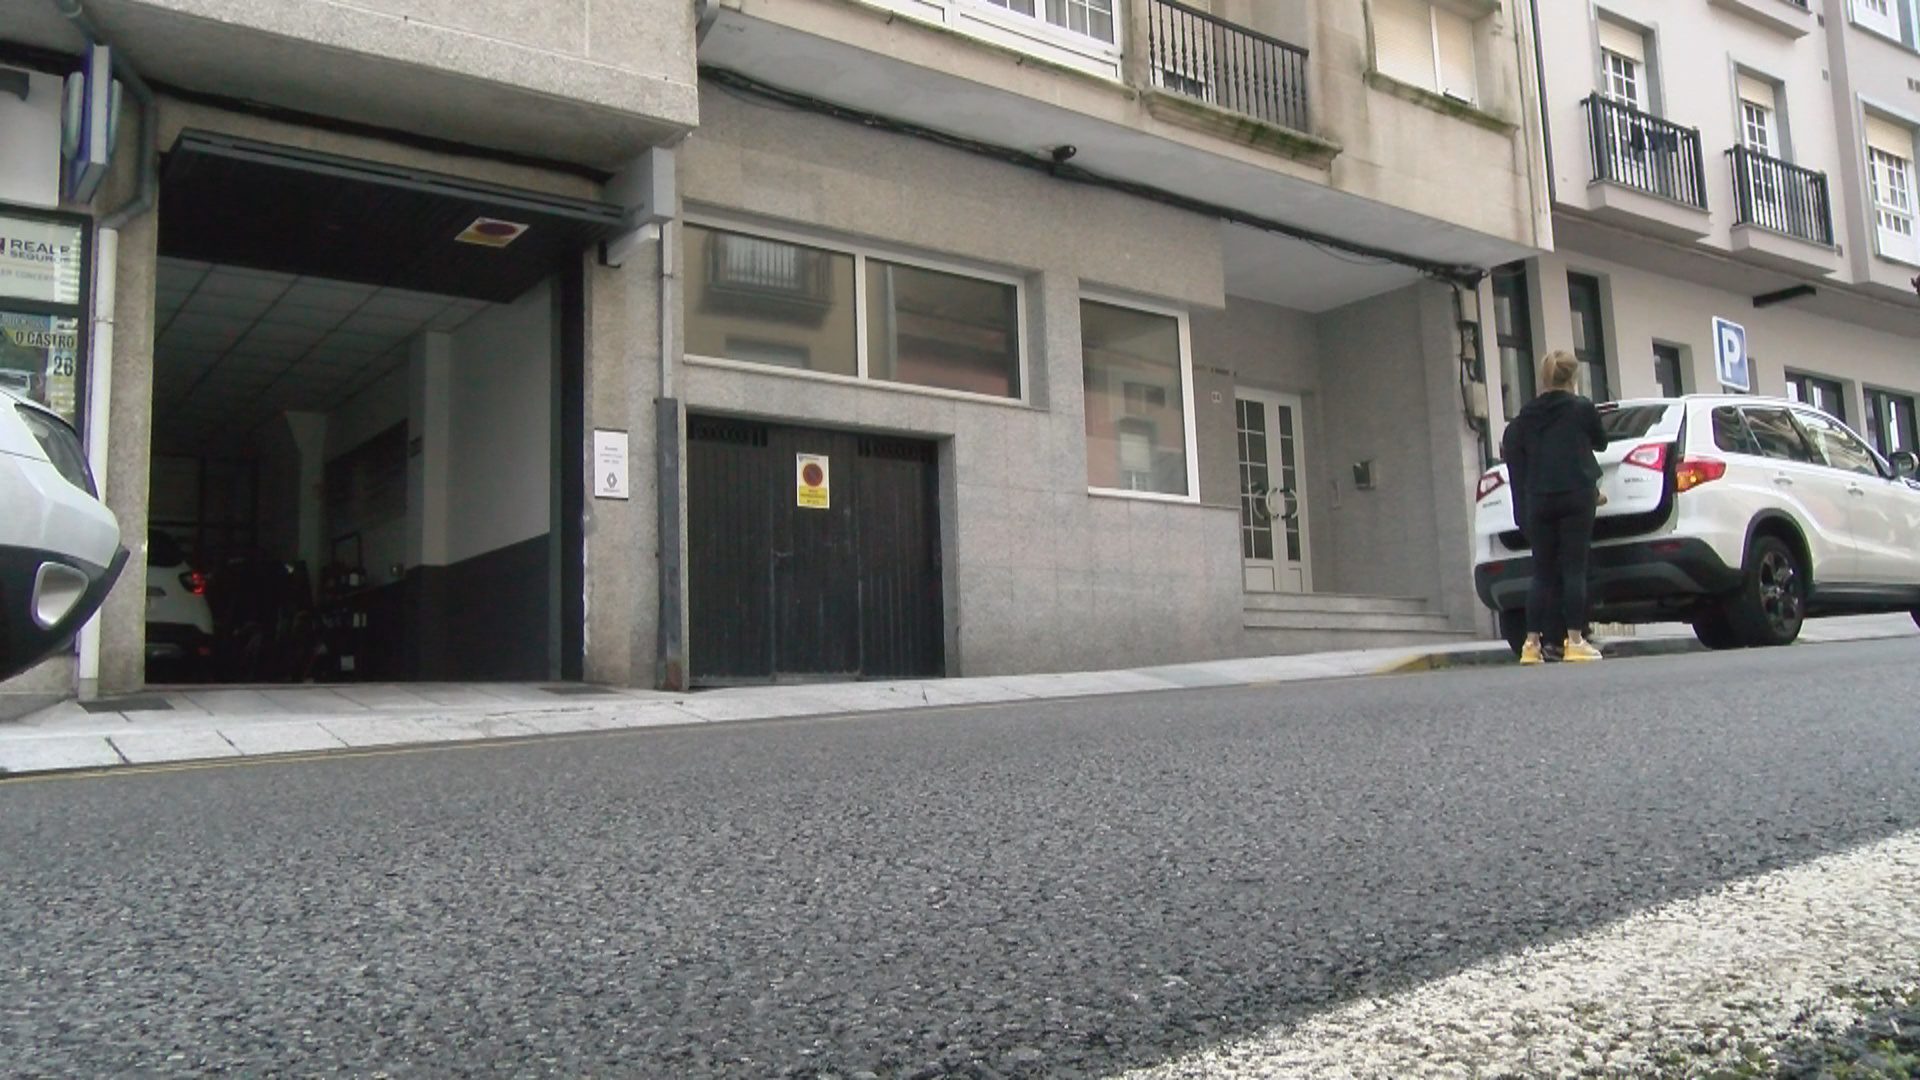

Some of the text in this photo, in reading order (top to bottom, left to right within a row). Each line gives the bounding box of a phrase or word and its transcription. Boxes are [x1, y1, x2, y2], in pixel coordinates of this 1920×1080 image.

[27, 331, 75, 349] CASTRO
[1721, 327, 1741, 379] P
[53, 356, 74, 377] 26
